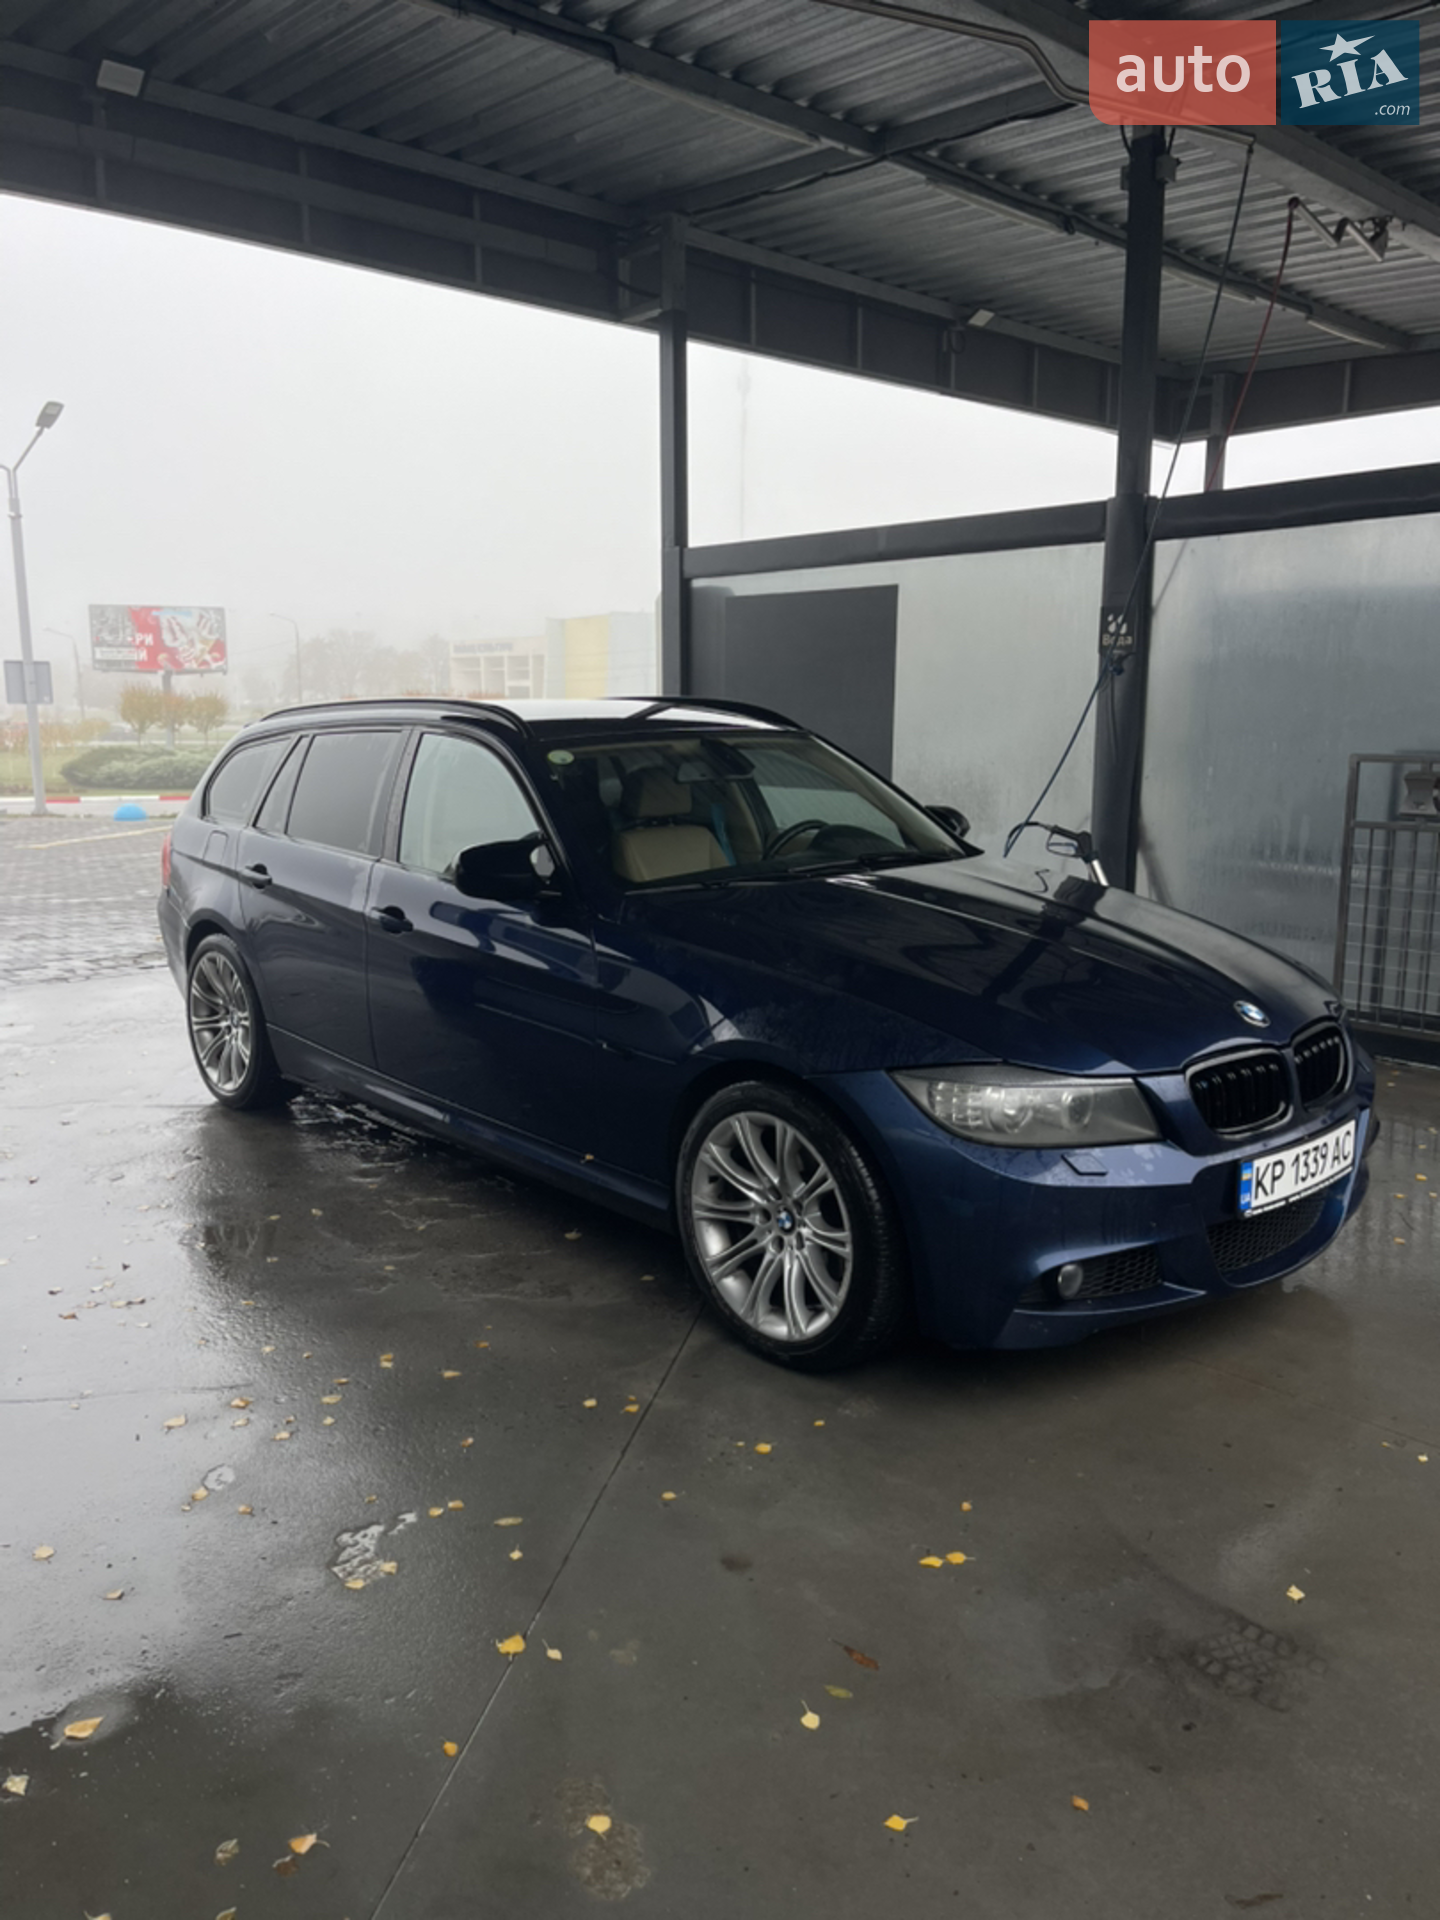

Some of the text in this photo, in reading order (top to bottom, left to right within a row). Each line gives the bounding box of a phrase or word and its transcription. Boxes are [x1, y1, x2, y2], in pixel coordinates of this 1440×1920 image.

[1254, 1159, 1286, 1200] KP
[1291, 1141, 1329, 1186] 1339
[1331, 1130, 1352, 1169] AC
